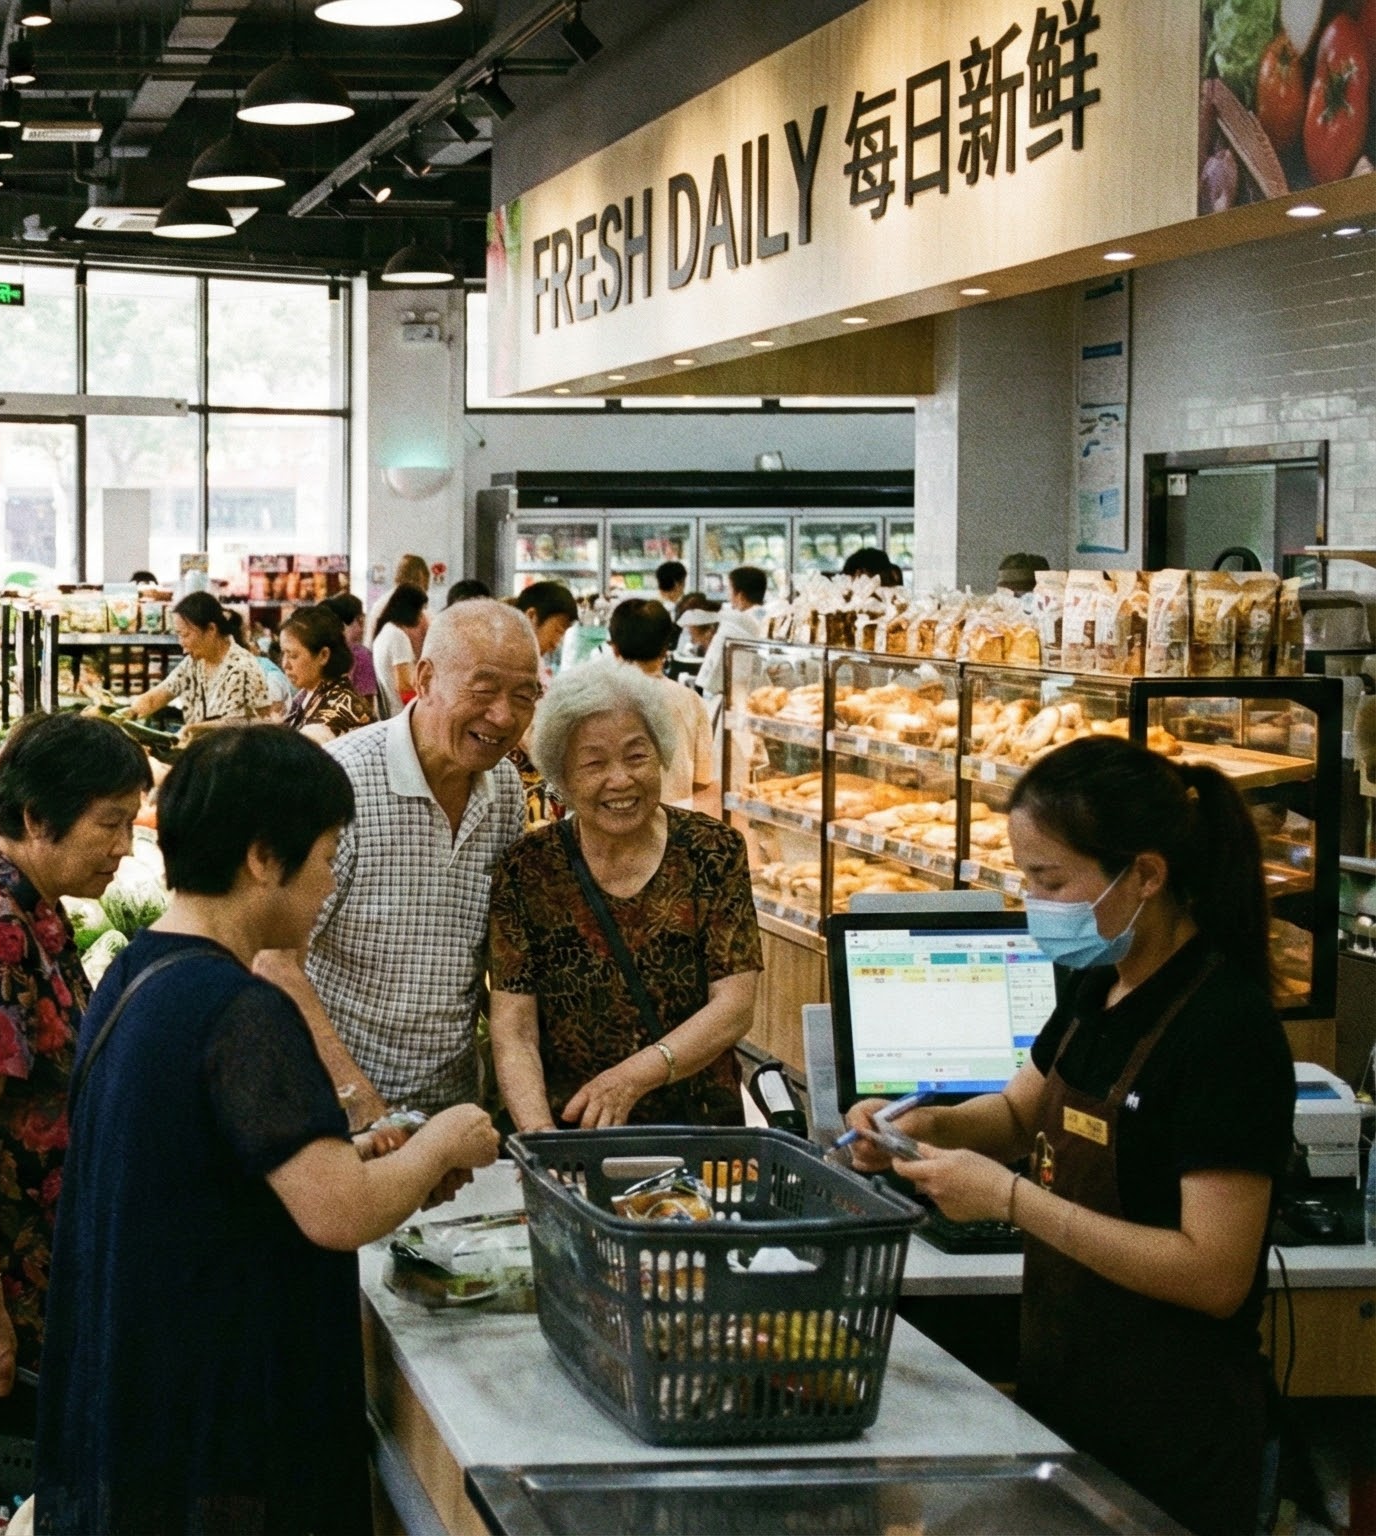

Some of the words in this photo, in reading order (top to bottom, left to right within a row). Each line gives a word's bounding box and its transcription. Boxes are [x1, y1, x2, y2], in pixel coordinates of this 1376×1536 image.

[533, 187, 653, 334] FRESH
[668, 104, 828, 290] DAILY
[843, 0, 1101, 220] 每日新鲜
